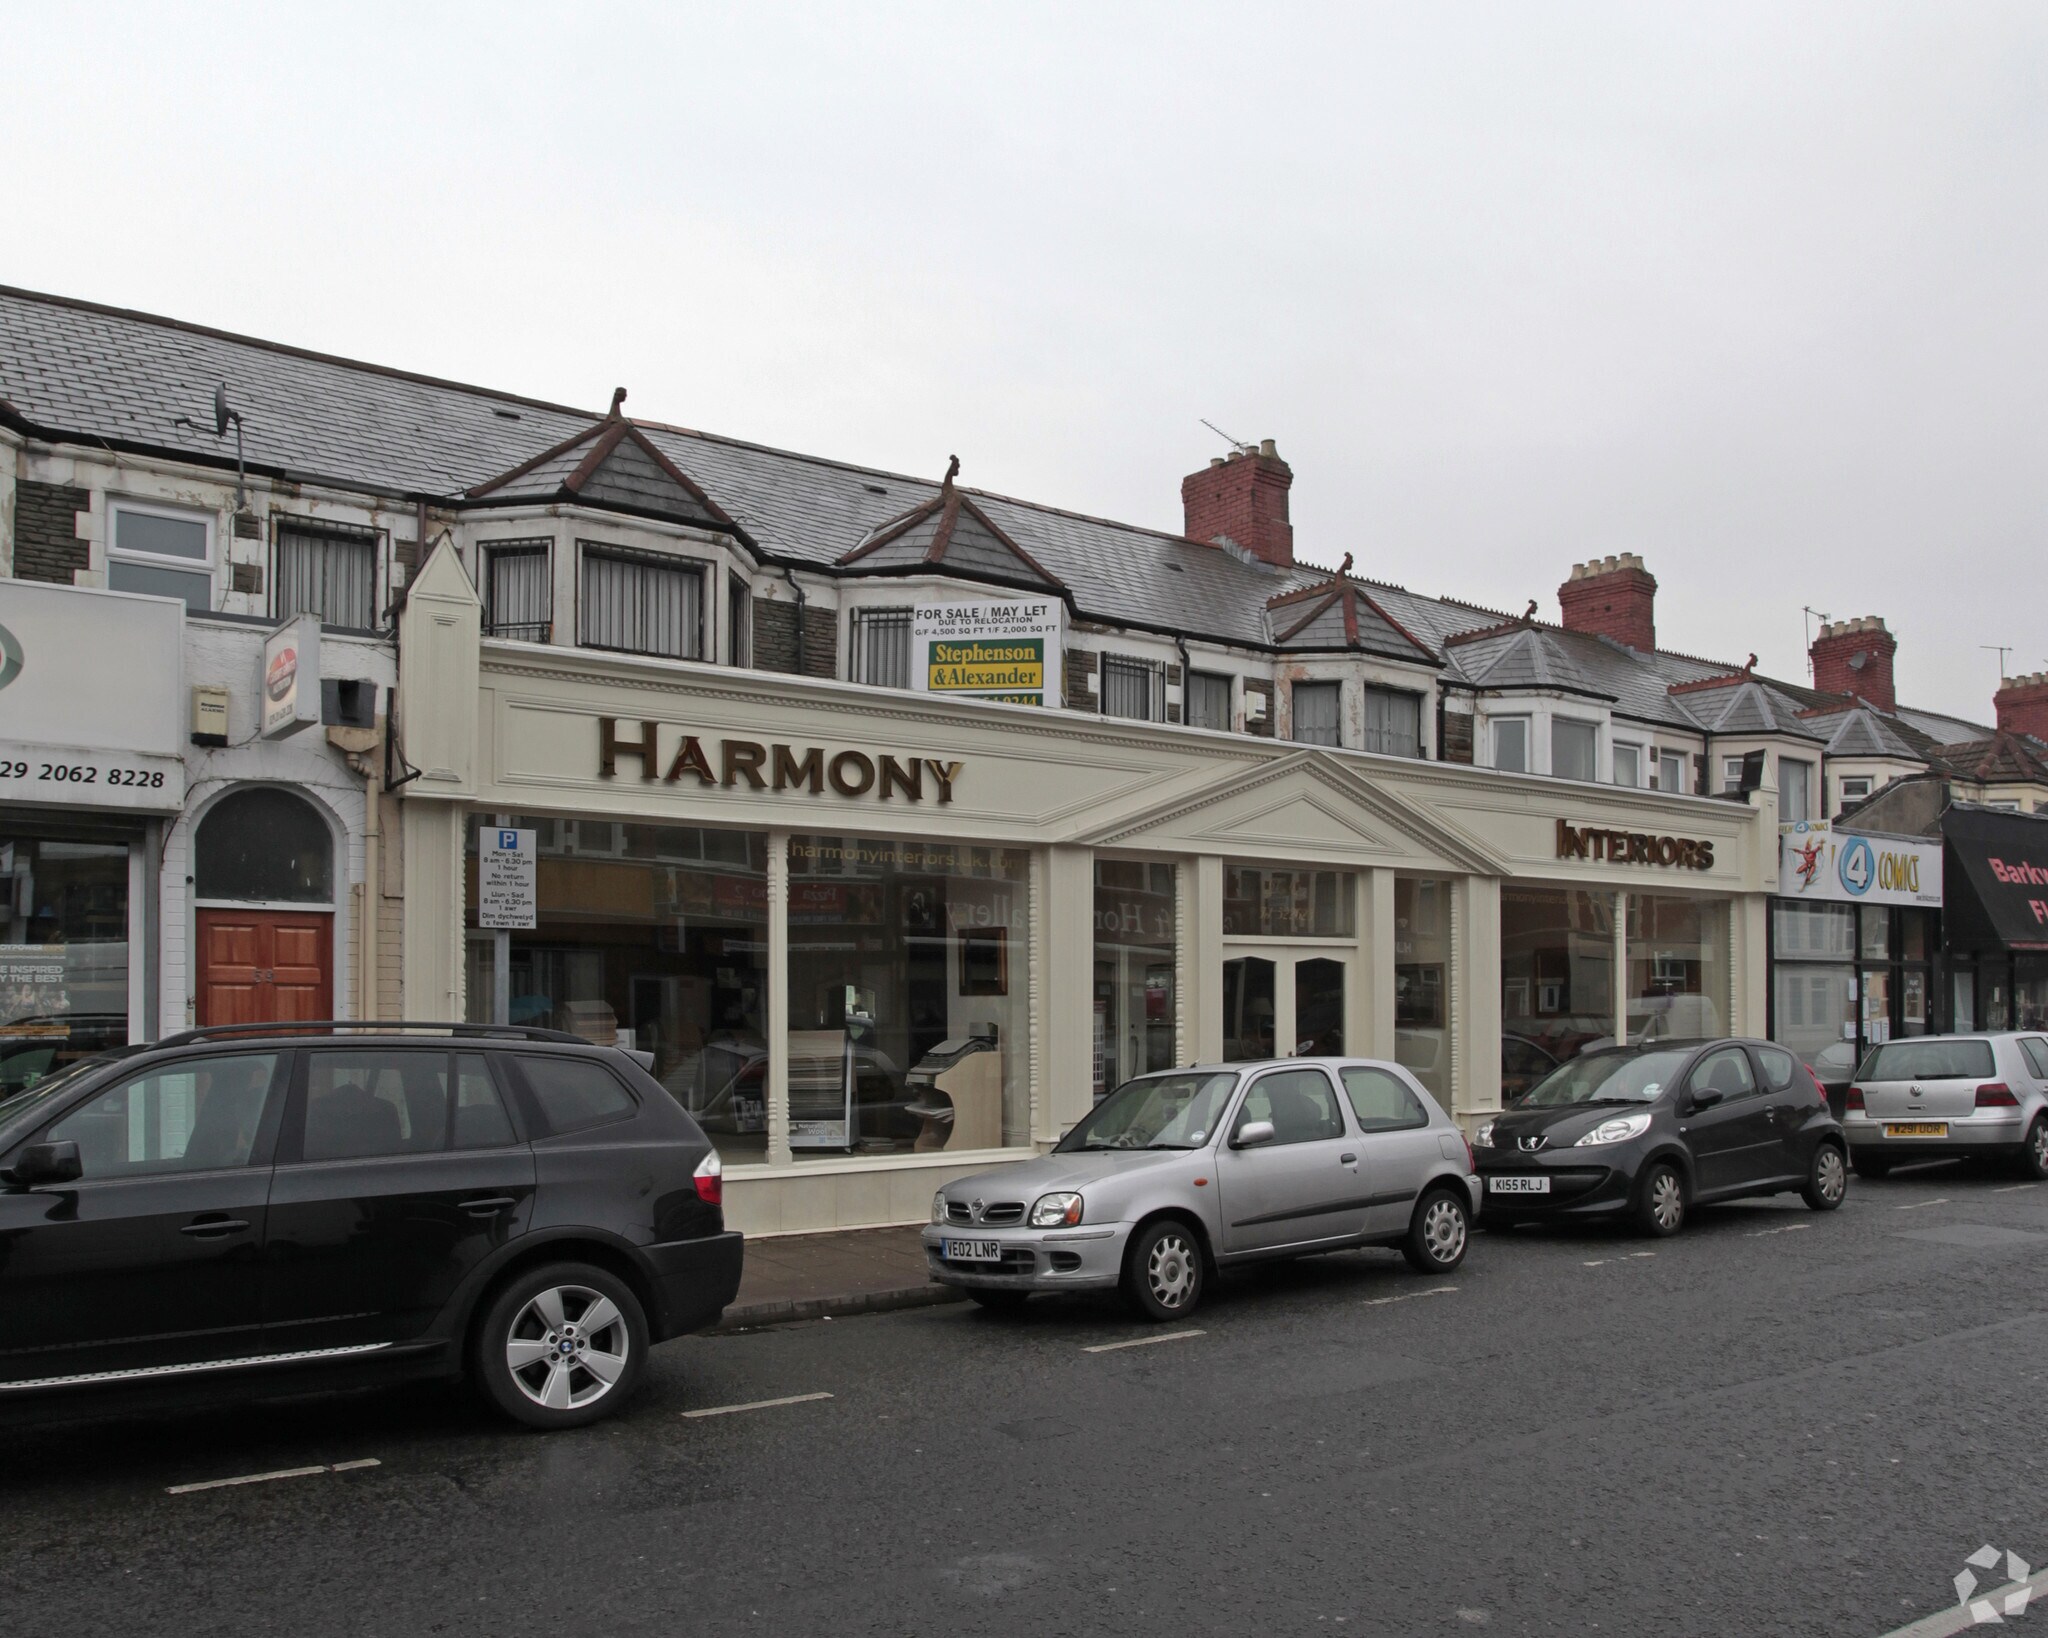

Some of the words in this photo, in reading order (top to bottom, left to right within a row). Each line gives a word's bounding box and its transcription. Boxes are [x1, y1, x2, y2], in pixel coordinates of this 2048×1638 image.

[916, 609, 942, 620] FOR
[946, 608, 979, 618] SALE
[991, 606, 1018, 617] MAY
[1024, 606, 1048, 616] LET
[974, 616, 1033, 625] RELOCATION
[936, 643, 1036, 665] Stephenson
[598, 718, 966, 804] HARMONY
[0, 761, 28, 779] 29
[38, 764, 98, 783] 2062
[108, 769, 164, 788] 8228
[504, 832, 515, 848] P
[1556, 818, 1714, 870] INTERIORS
[1846, 844, 1868, 888] 4
[10, 966, 63, 974] INSPIRED
[1521, 1180, 1542, 1190] RLJ
[947, 1242, 972, 1257] VE02
[974, 1243, 998, 1258] LNR
